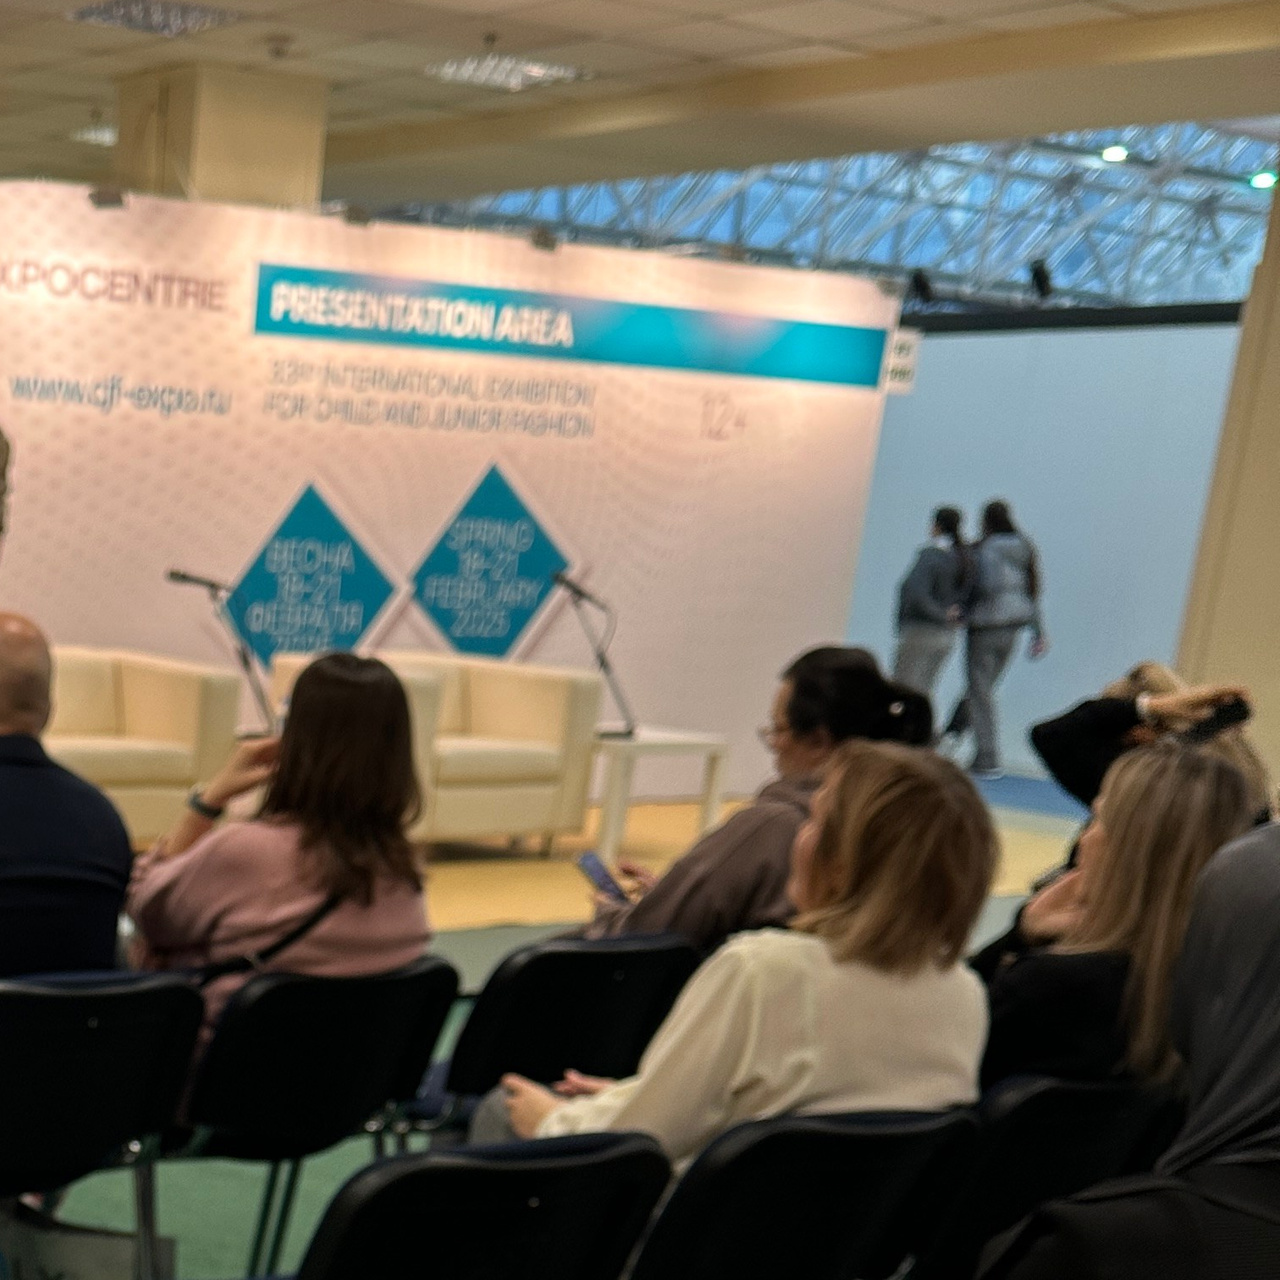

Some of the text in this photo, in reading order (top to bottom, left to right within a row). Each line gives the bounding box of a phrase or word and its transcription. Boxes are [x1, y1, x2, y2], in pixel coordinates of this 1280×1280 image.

[270, 279, 574, 347] PRESENTATION AREA
[323, 361, 483, 400] INTERNATIONAL
[485, 376, 597, 408] EXHIBITION
[447, 516, 535, 552] SPRING
